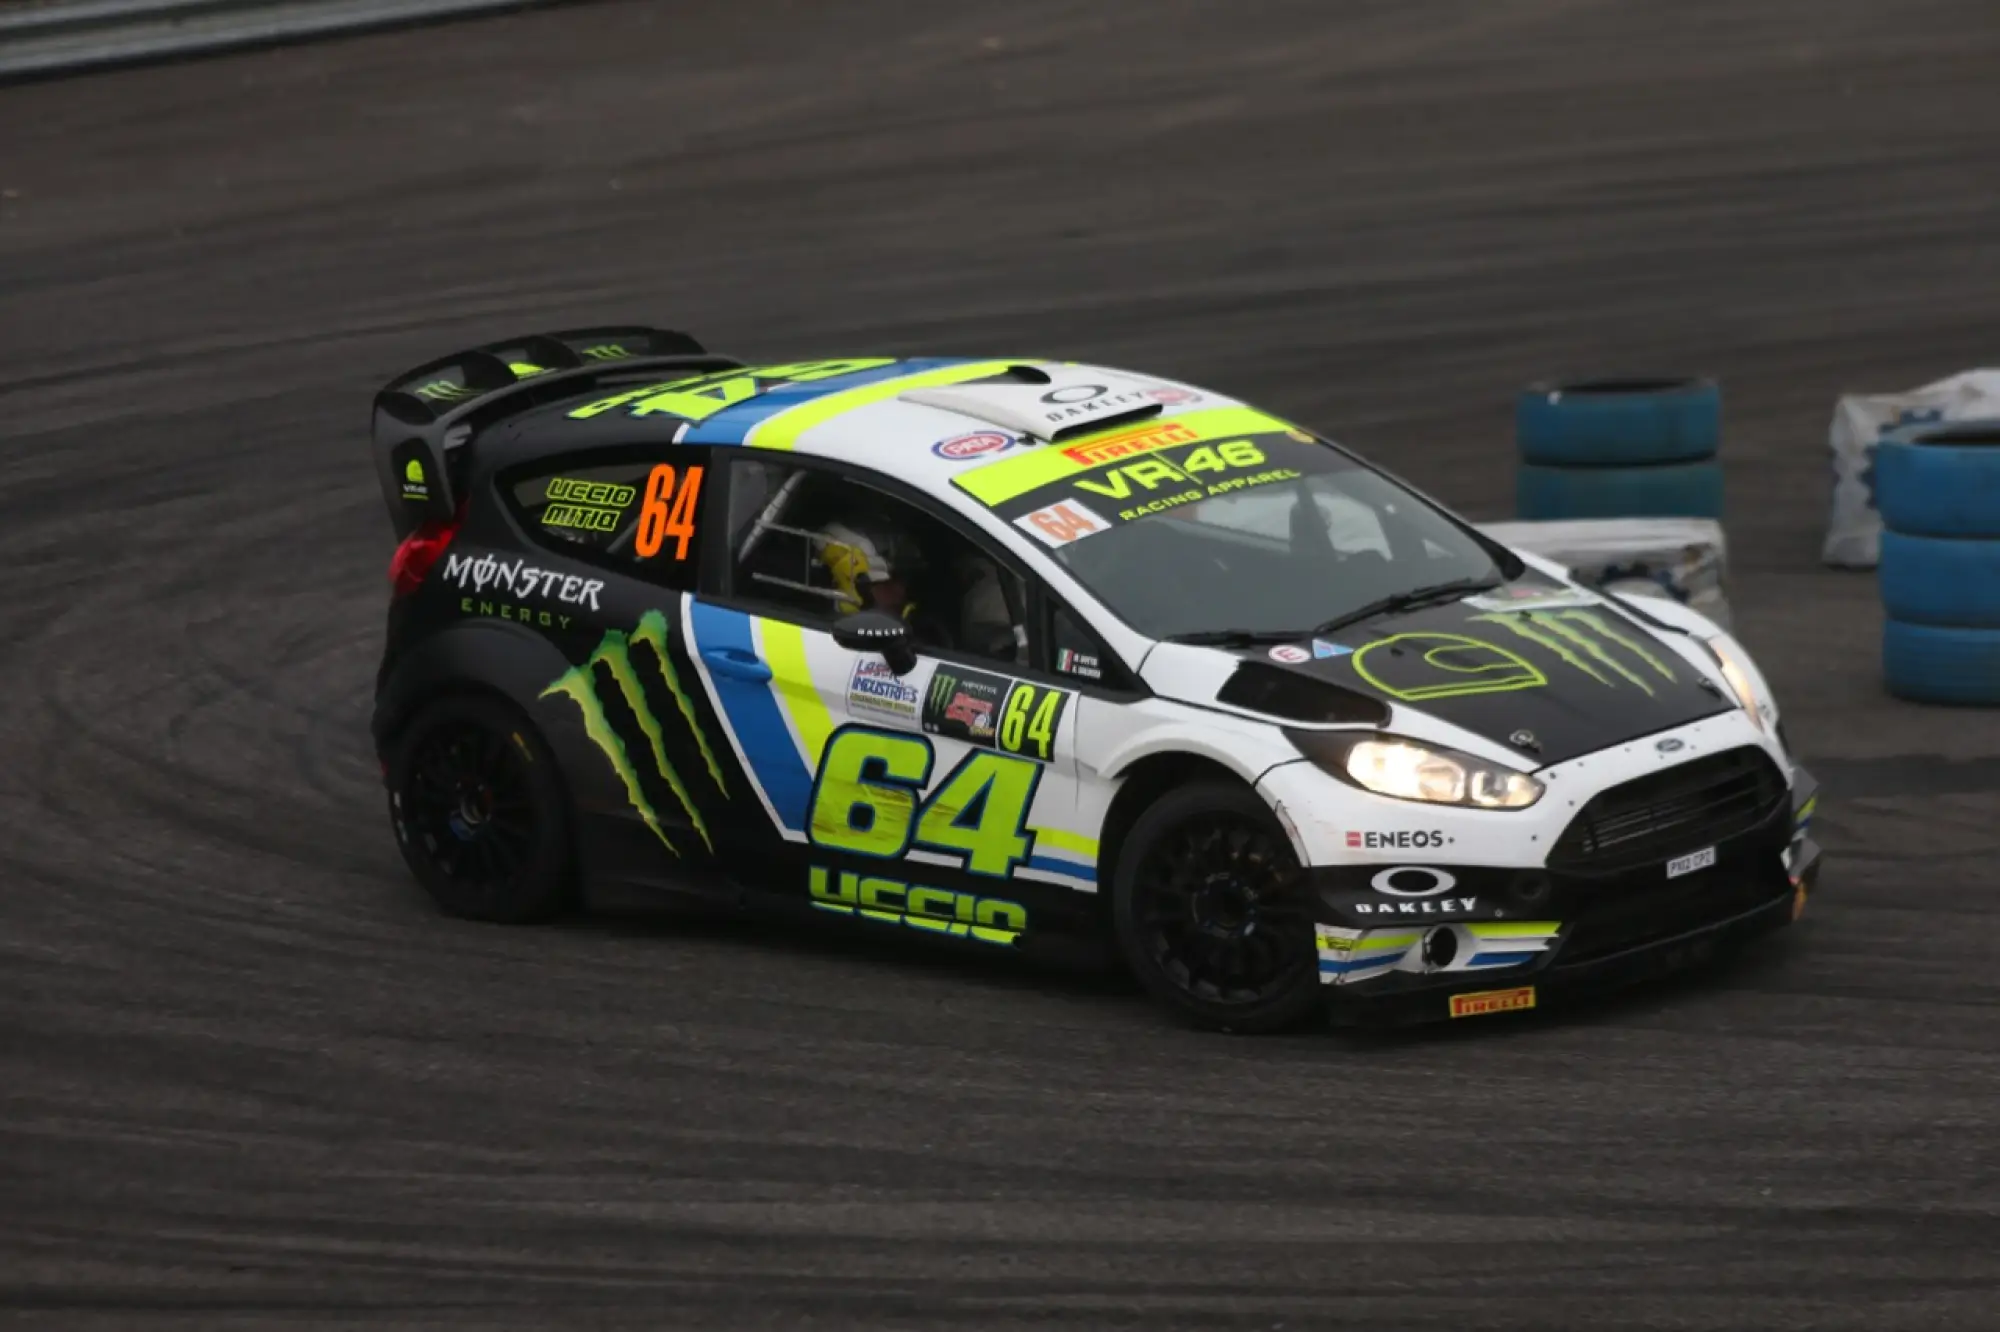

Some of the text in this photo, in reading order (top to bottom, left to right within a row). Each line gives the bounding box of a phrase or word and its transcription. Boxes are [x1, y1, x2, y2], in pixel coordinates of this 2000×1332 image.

[1046, 391, 1144, 422] OAKLEY
[1060, 423, 1199, 466] PIRELLI
[1183, 439, 1267, 472] 46
[546, 477, 636, 508] UCCIO
[1118, 470, 1301, 521] RACING APPAREL
[634, 463, 704, 561] 64
[1029, 503, 1099, 542] 64
[461, 597, 572, 631] ENERGY
[1000, 683, 1062, 761] 64
[808, 725, 1040, 879] 64
[1364, 830, 1444, 848] ENEOS
[808, 865, 1028, 946] UCCIO
[1355, 897, 1477, 913] OAKLEY
[1453, 989, 1532, 1015] PIRELLI
